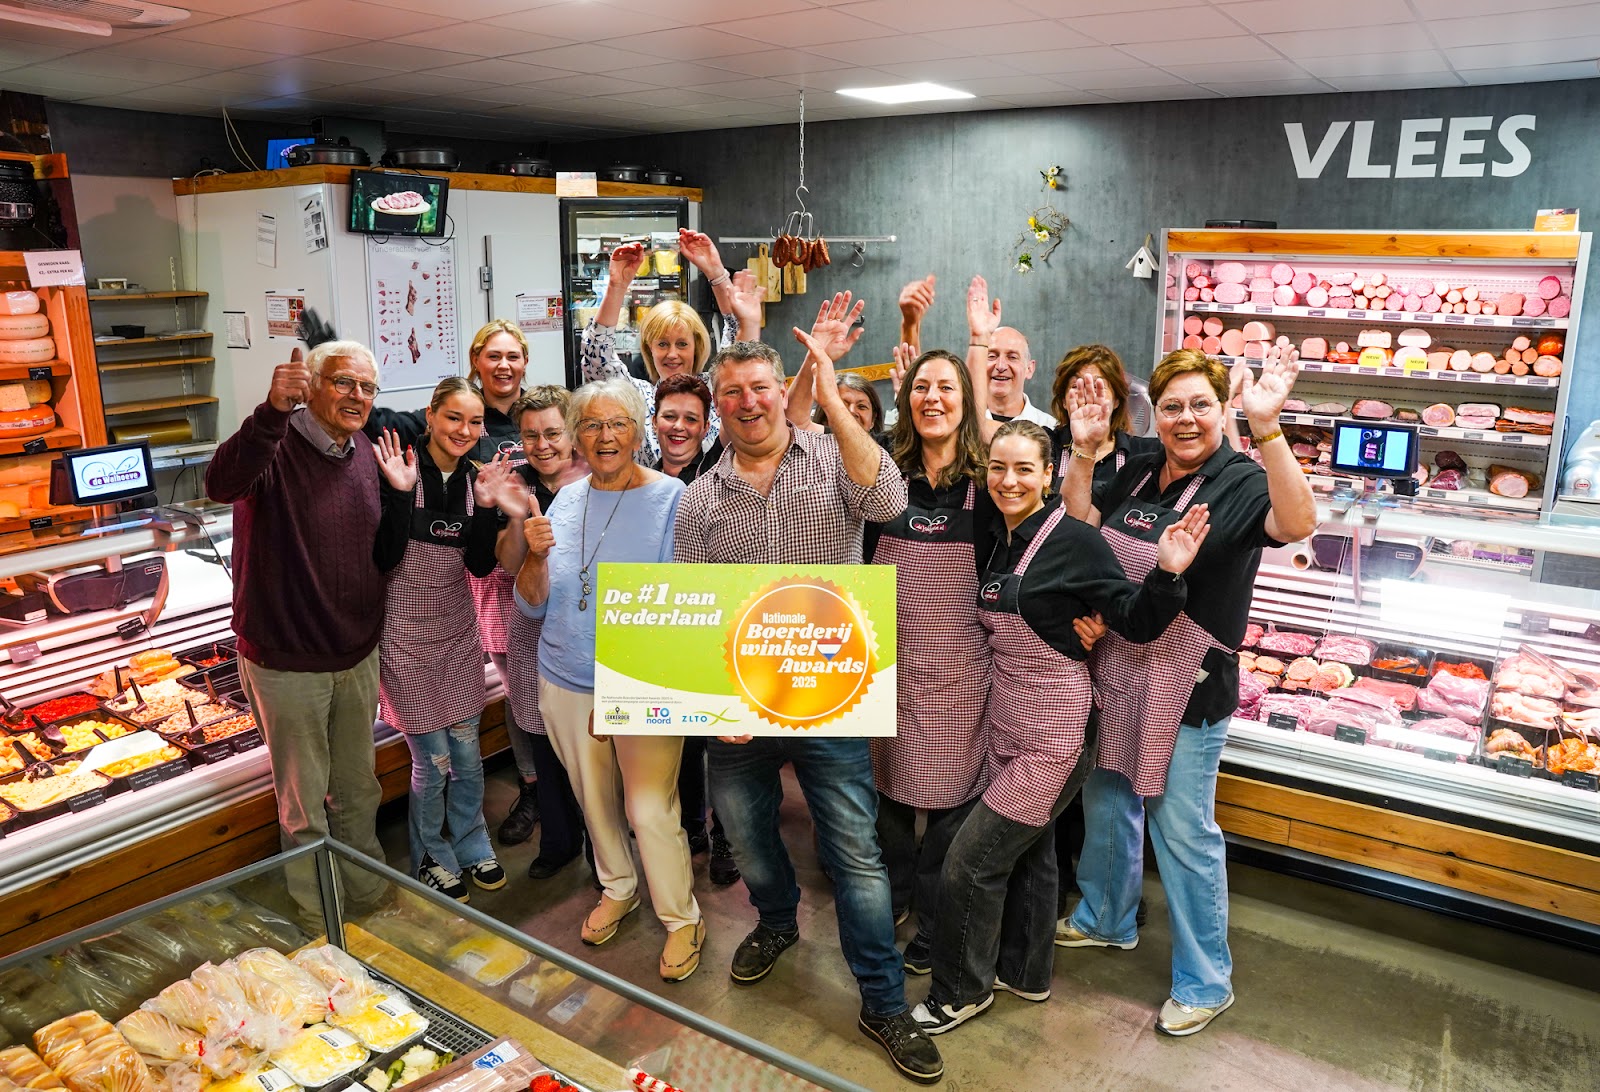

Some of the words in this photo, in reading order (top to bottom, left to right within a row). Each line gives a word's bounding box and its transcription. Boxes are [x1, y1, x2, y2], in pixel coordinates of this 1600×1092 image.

[1283, 114, 1537, 179] VLEES
[92, 478, 102, 486] de
[103, 471, 139, 485] Walhoeve
[603, 589, 632, 605] De
[637, 583, 670, 605] #1
[674, 592, 716, 605] van
[602, 609, 723, 626] Nederland
[762, 613, 806, 624] Nationale
[746, 623, 853, 643] Boerderij
[740, 640, 818, 656] winkel
[778, 657, 864, 673] Awards
[791, 676, 817, 688] 2025
[646, 707, 670, 717] LTO
